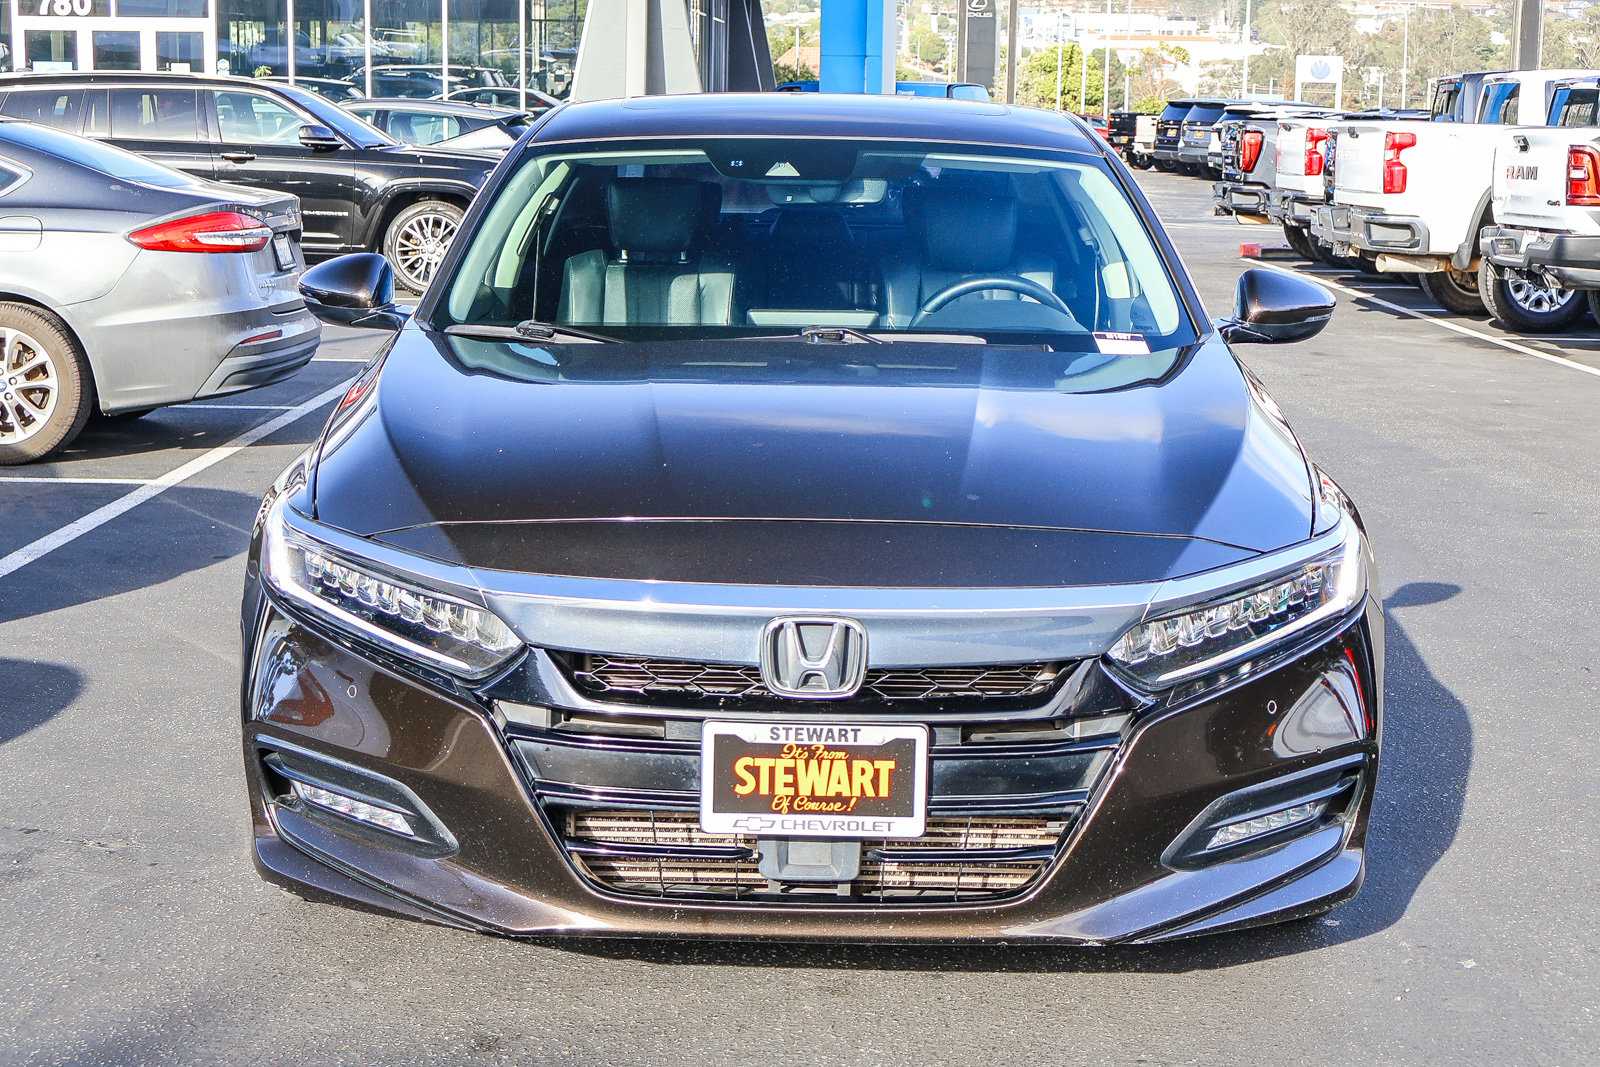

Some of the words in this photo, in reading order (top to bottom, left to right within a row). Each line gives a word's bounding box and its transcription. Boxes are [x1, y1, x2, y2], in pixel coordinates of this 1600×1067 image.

[1506, 166, 1538, 180] RAM
[769, 726, 862, 743] STEWART
[780, 743, 809, 760] It's
[810, 744, 850, 760] From
[733, 756, 896, 798] STEWART
[771, 794, 790, 815] Of
[780, 819, 896, 833] CHEVROLET
